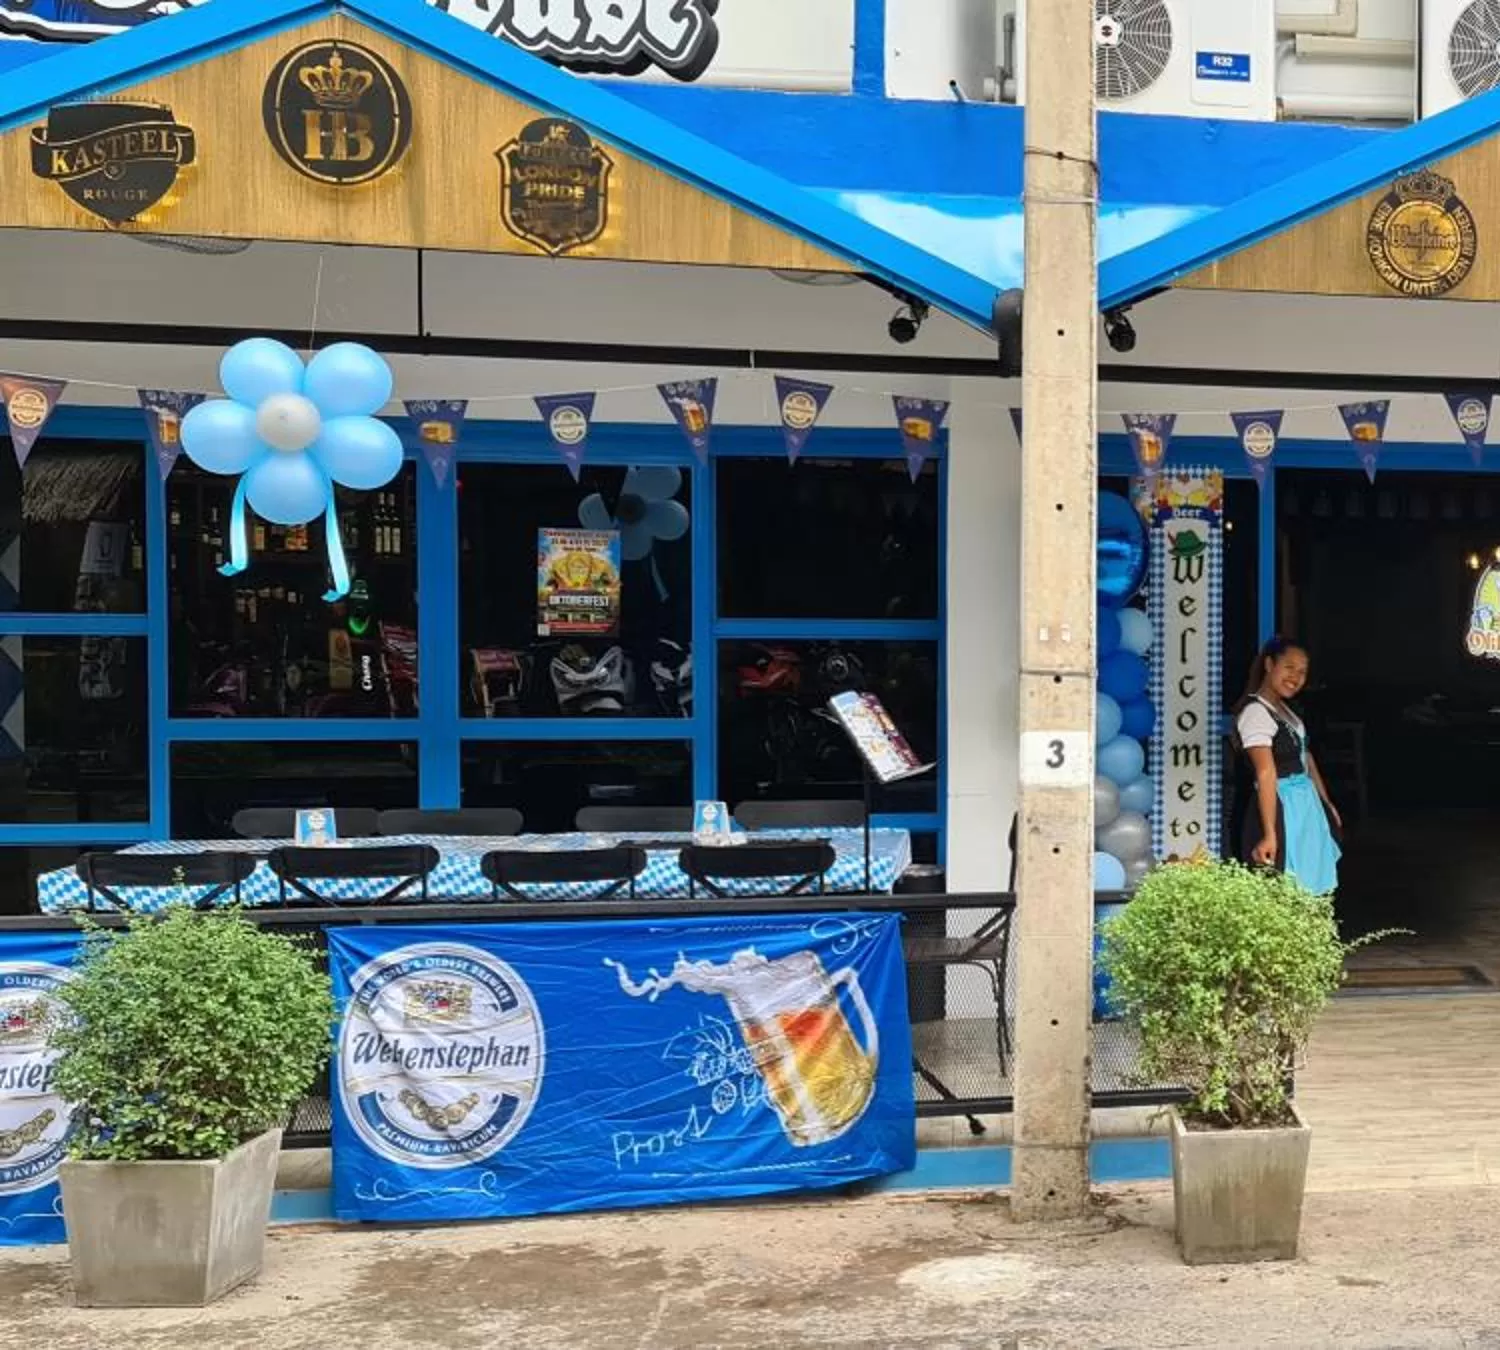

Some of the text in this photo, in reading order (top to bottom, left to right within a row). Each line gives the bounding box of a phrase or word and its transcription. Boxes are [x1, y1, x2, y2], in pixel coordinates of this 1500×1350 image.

[51, 129, 177, 175] KASTEEL
[302, 110, 374, 160] HB
[83, 188, 150, 201] ROUGE
[524, 182, 585, 199] PRIDE
[1170, 555, 1204, 838] Welcome to
[1045, 739, 1066, 769] 3
[611, 1103, 713, 1170] Prost
